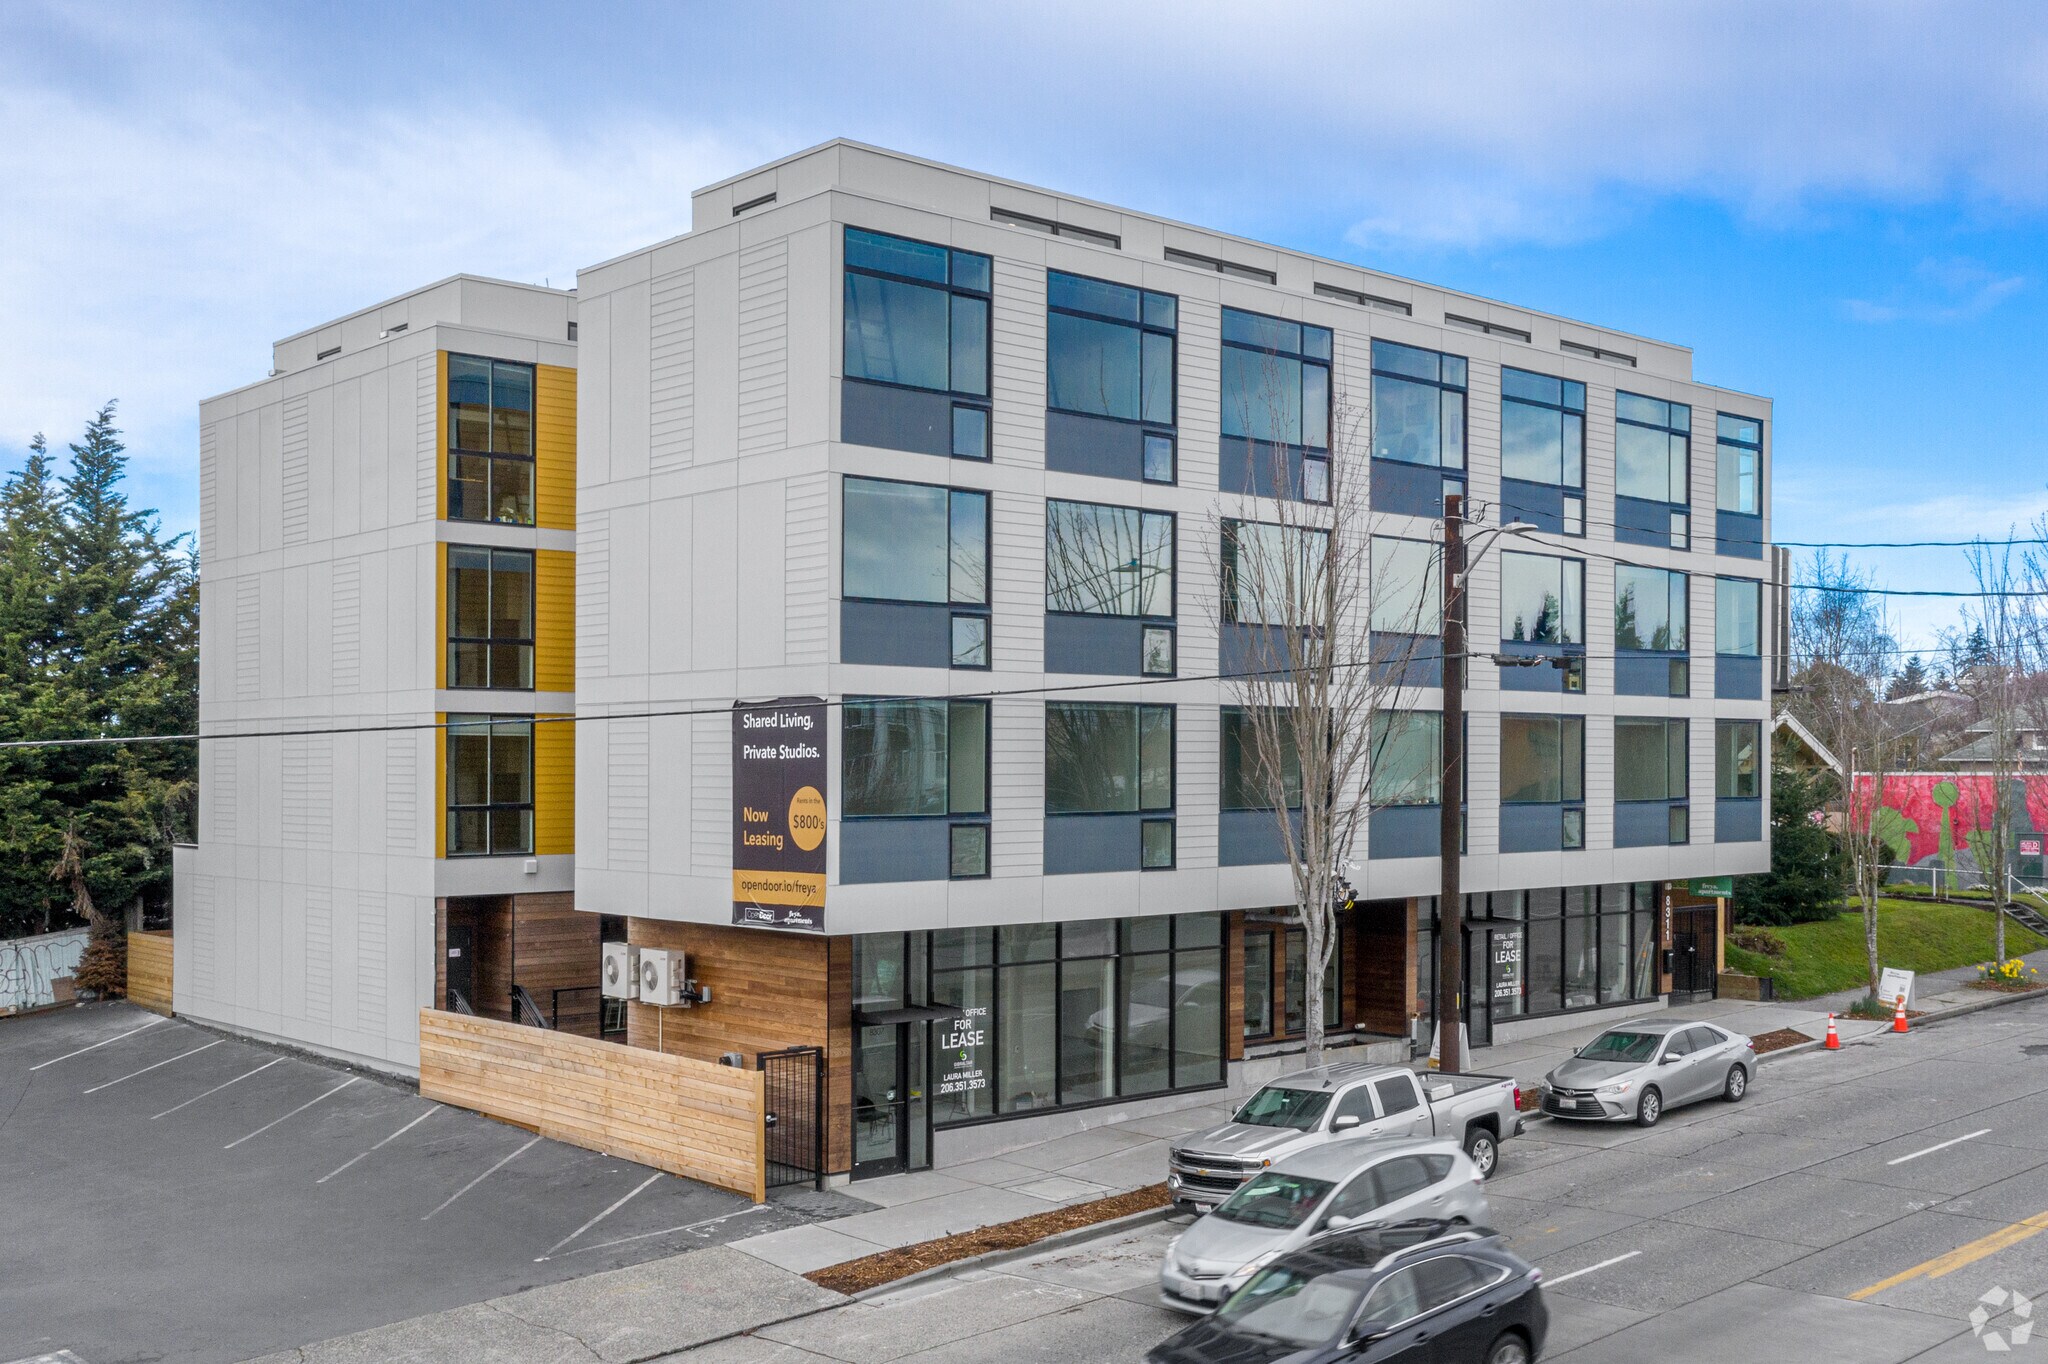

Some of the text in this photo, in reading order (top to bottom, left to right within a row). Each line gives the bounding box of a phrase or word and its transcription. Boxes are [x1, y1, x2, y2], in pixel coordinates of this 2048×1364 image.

[743, 712, 814, 730] Shared Living,
[743, 743, 820, 760] Private Studios.
[743, 807, 769, 822] Now
[793, 814, 825, 830] $800's
[743, 830, 784, 851] Leasing
[741, 879, 817, 894] opendoor.io/freya
[1502, 940, 1514, 949] FOR
[1495, 949, 1521, 963] LEASE
[965, 1007, 987, 1017] OFFICE
[954, 1019, 972, 1031] FOR
[941, 1030, 984, 1049] LEASE
[943, 1069, 983, 1081] LAURA MILLER
[940, 1079, 986, 1093] 206.351.3573
